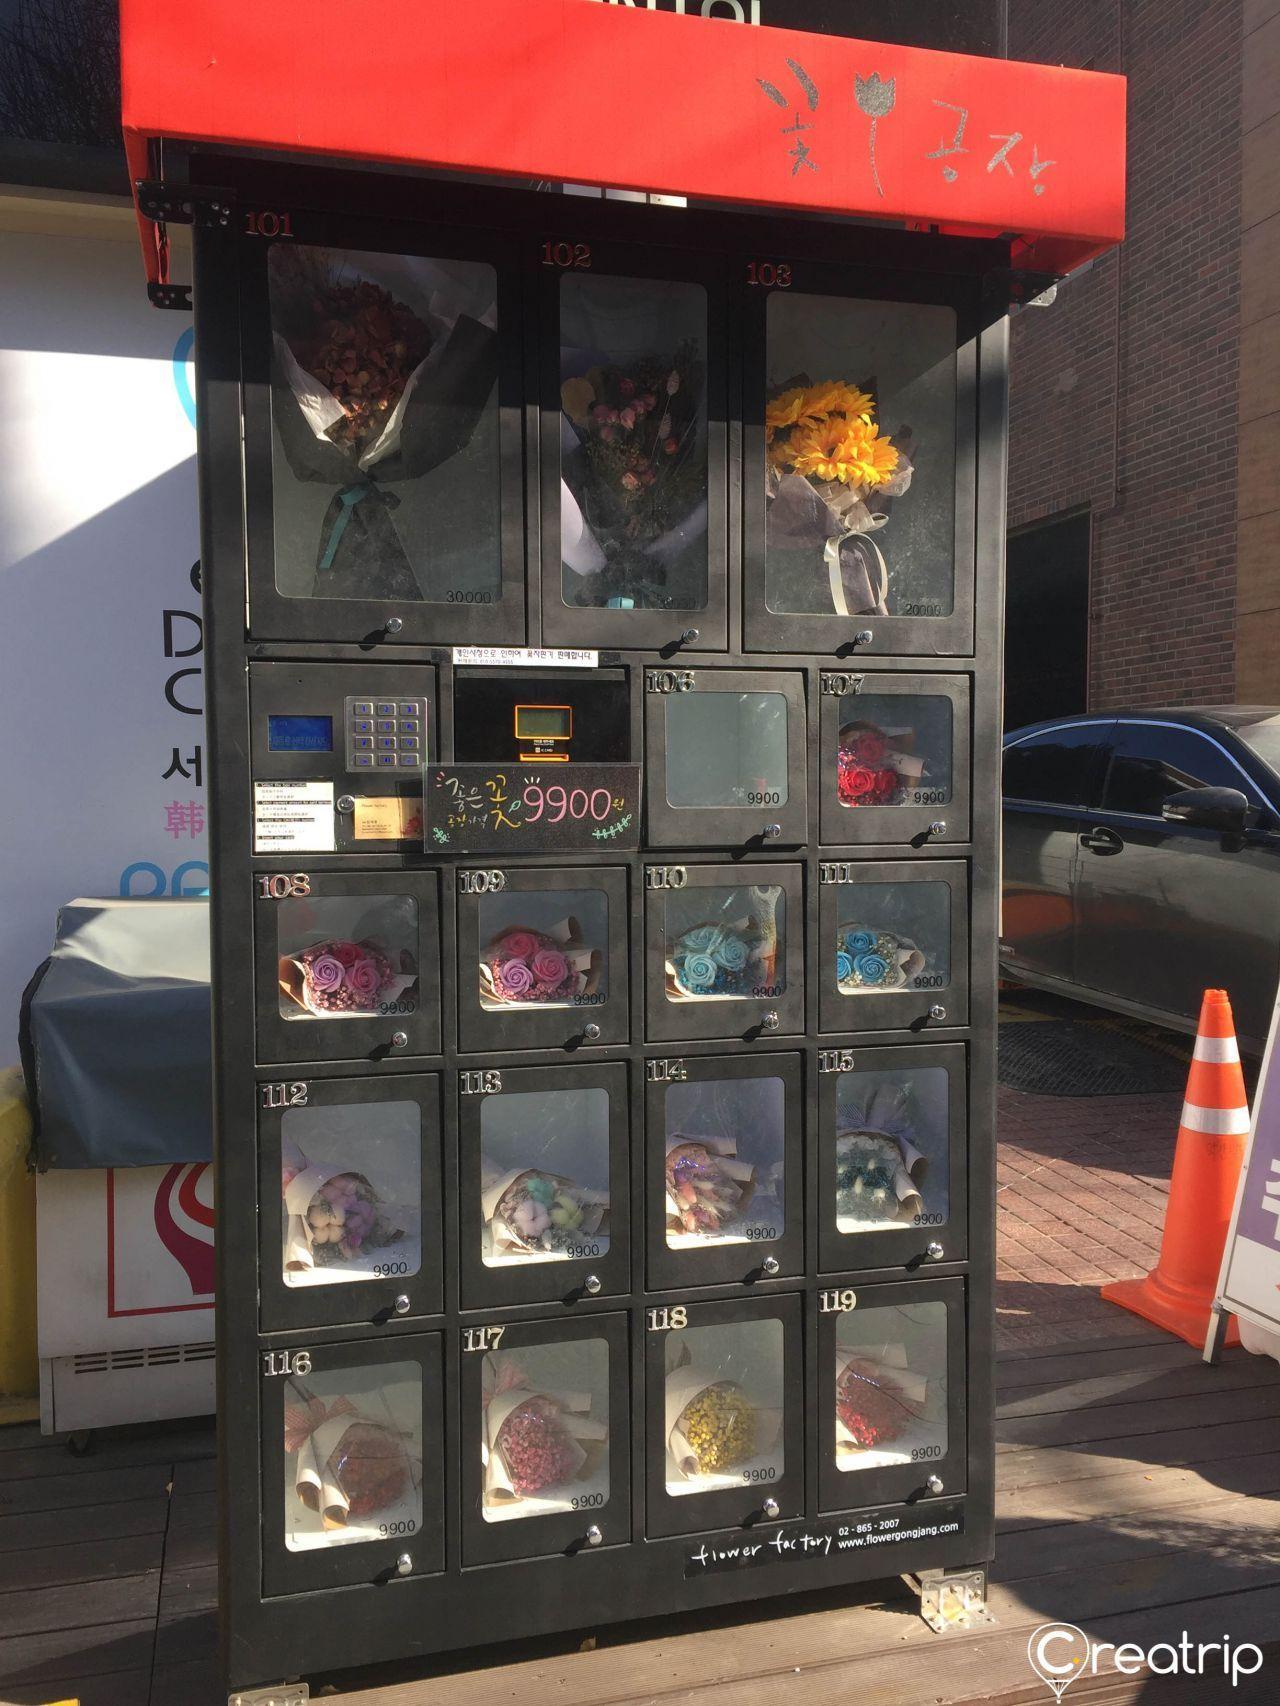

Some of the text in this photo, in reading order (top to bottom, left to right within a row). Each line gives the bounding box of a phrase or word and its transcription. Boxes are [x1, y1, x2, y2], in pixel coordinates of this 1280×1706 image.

[924, 99, 1058, 196] 공장
[245, 211, 294, 237] 101
[541, 240, 592, 269] 102
[746, 262, 793, 287] 103
[446, 590, 492, 604] 30000
[905, 603, 943, 617] 20000
[647, 671, 696, 693] 106
[821, 673, 866, 697] 107
[747, 791, 780, 805] 9900
[913, 791, 946, 806] 9900
[460, 869, 507, 895] 109
[646, 866, 688, 890] 110
[820, 863, 854, 884] 111
[259, 872, 312, 900] 108
[752, 985, 782, 999] 9900
[914, 975, 943, 989] 9900
[379, 1001, 415, 1015] 9900
[573, 992, 607, 1006] 9900
[646, 1058, 687, 1082] 114
[818, 1049, 855, 1073] 115
[460, 1070, 503, 1095] 113
[262, 1082, 309, 1109] 112
[913, 1213, 943, 1226] 9900
[746, 1227, 777, 1241] 9900
[566, 1244, 600, 1259] 9900
[373, 1262, 408, 1278] 9900
[819, 1290, 857, 1313] 119
[647, 1306, 688, 1332] 118
[463, 1325, 507, 1352] 117
[264, 1350, 312, 1377] 116
[911, 1445, 942, 1460] 9900
[742, 1467, 776, 1482] 9900
[570, 1492, 604, 1510] 9900
[378, 1519, 416, 1536] 9900
[838, 1521, 959, 1549] www.flowergongjang.com
[879, 1519, 900, 1530] 2007
[691, 1530, 832, 1566] flower factory
